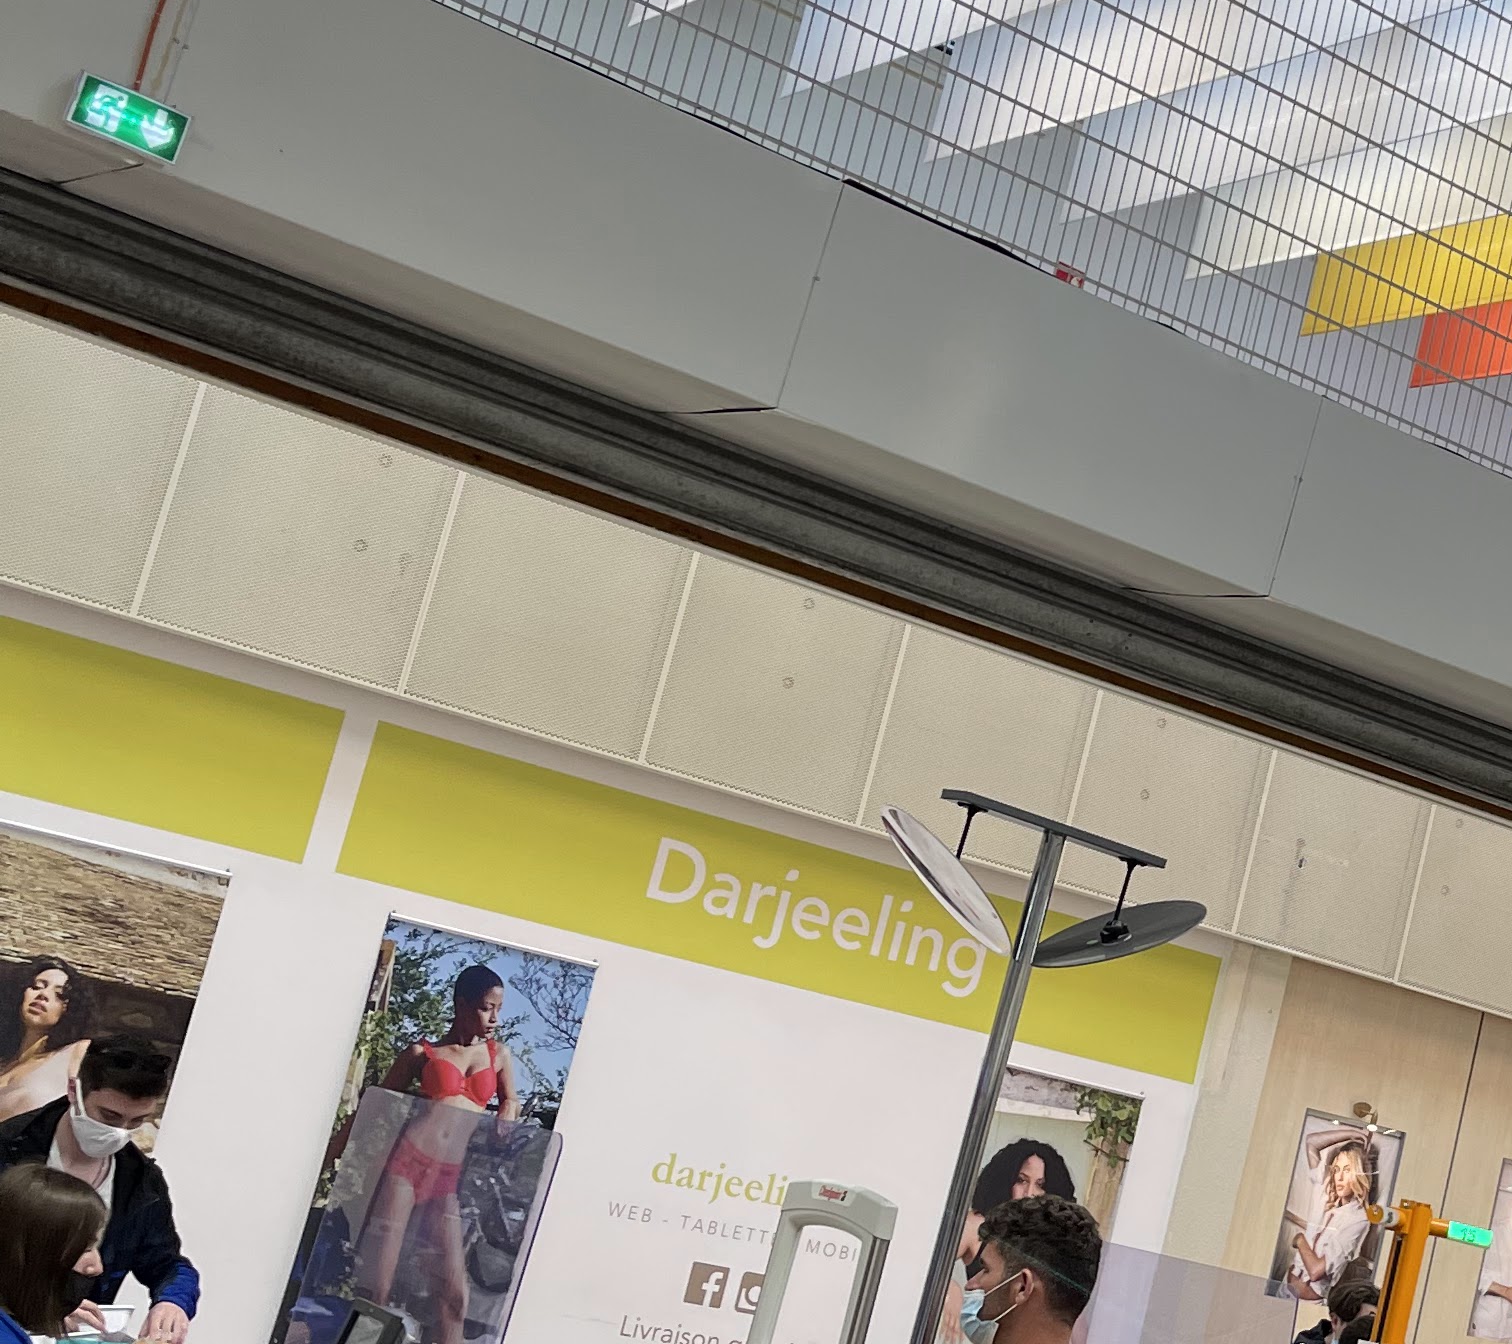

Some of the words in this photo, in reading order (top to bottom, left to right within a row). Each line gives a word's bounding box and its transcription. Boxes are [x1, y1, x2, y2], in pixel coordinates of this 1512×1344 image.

[645, 837, 986, 997] Darjeeling
[652, 1152, 788, 1206] darjeeli
[608, 1201, 653, 1223] WEB
[681, 1215, 777, 1246] TABLETT
[805, 1239, 857, 1261] MOBI
